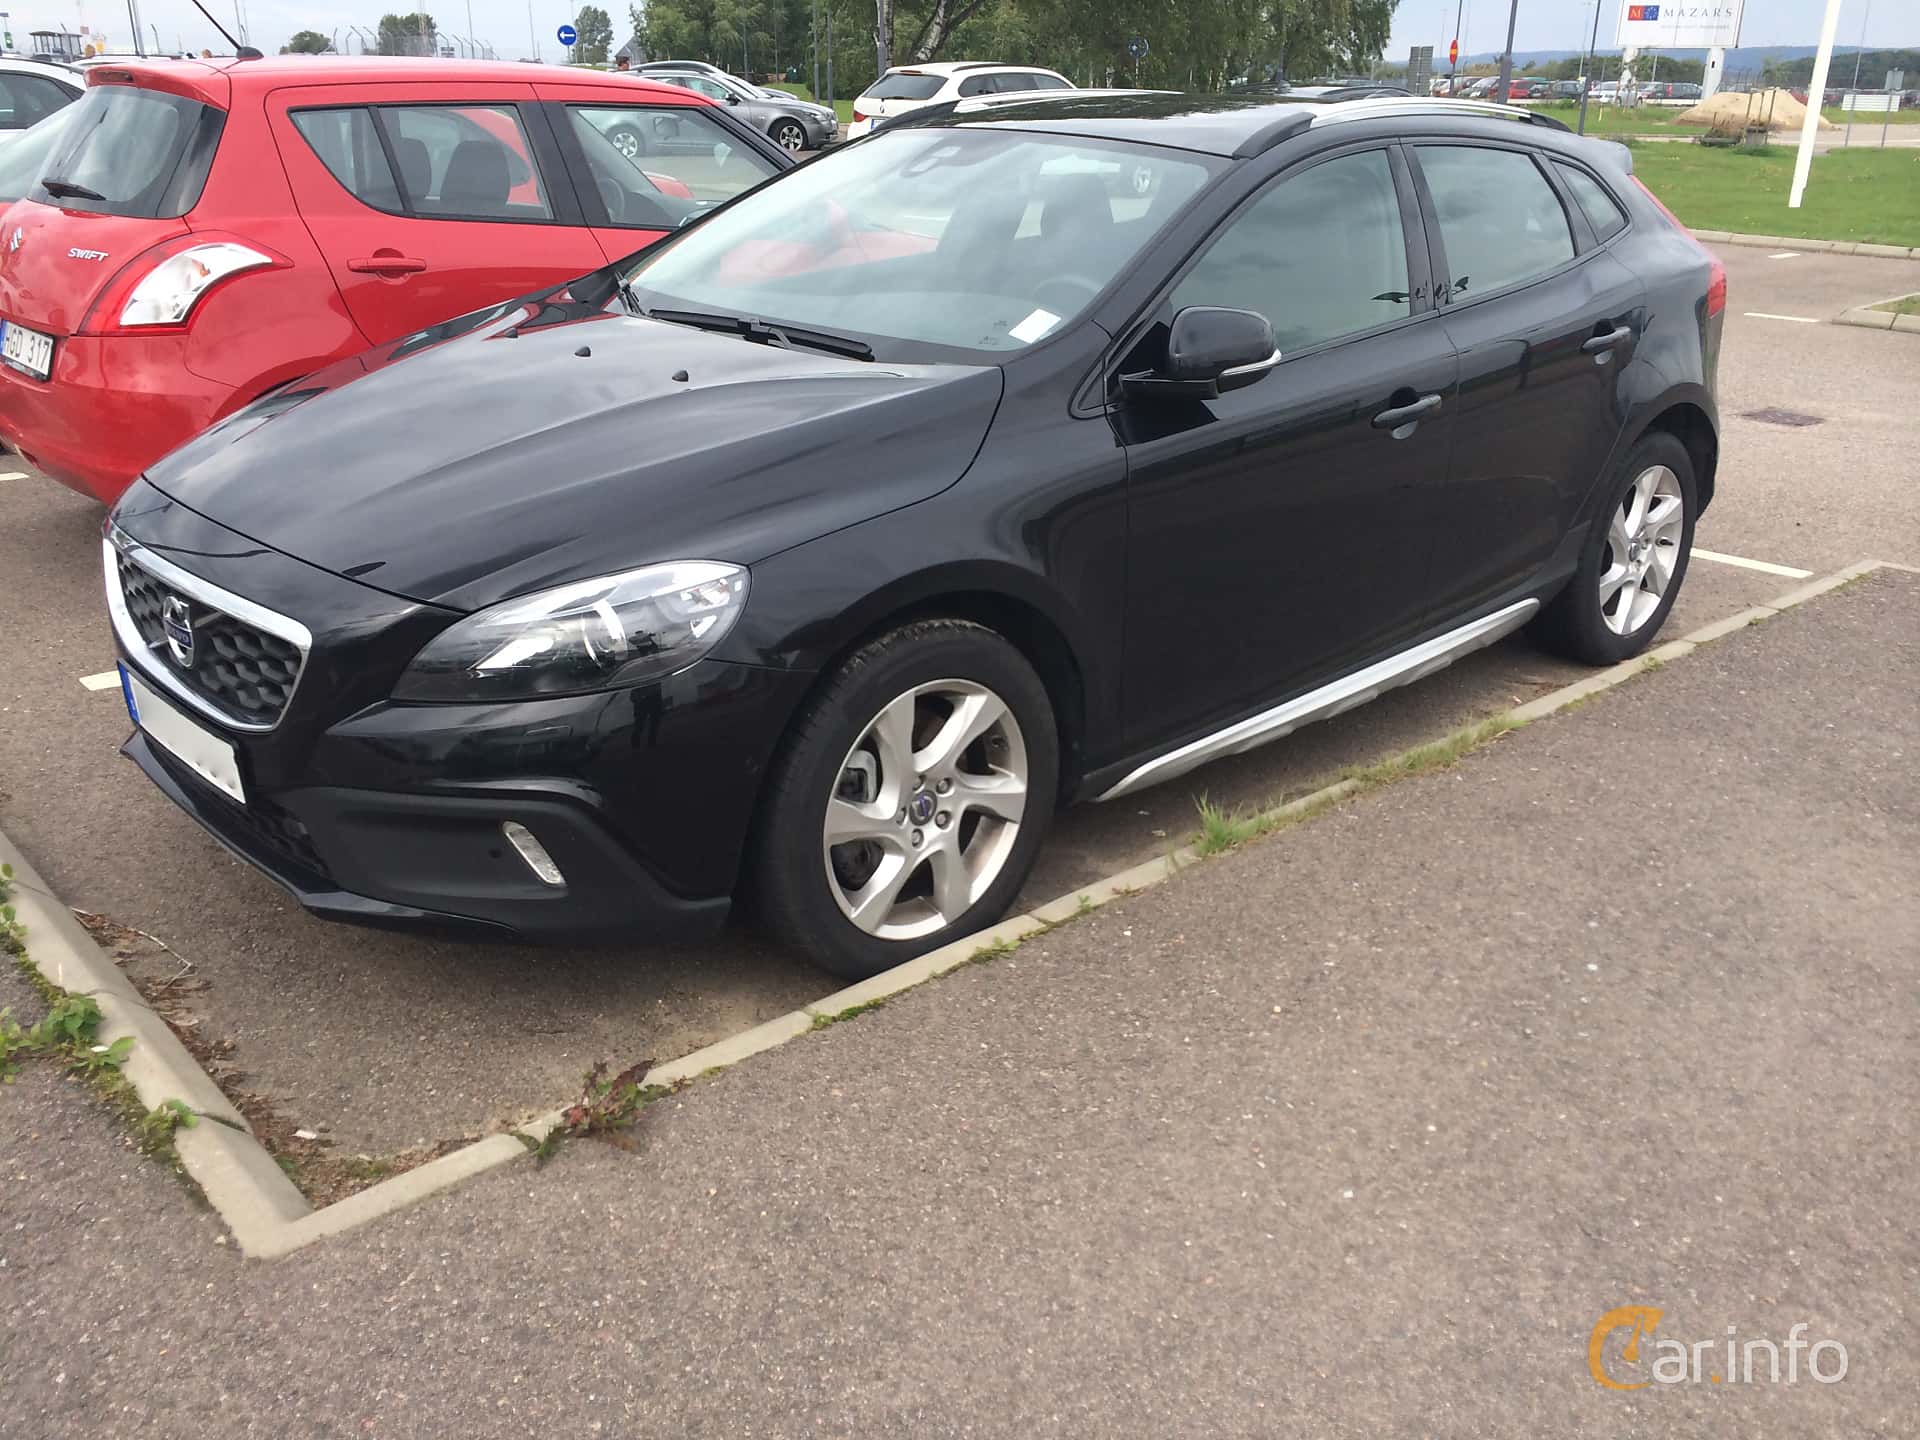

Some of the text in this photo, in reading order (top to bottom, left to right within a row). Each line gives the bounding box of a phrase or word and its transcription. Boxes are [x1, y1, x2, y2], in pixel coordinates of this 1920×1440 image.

[1663, 7, 1733, 17] MAZARS
[67, 247, 109, 262] SWIFT
[28, 335, 50, 369] 317
